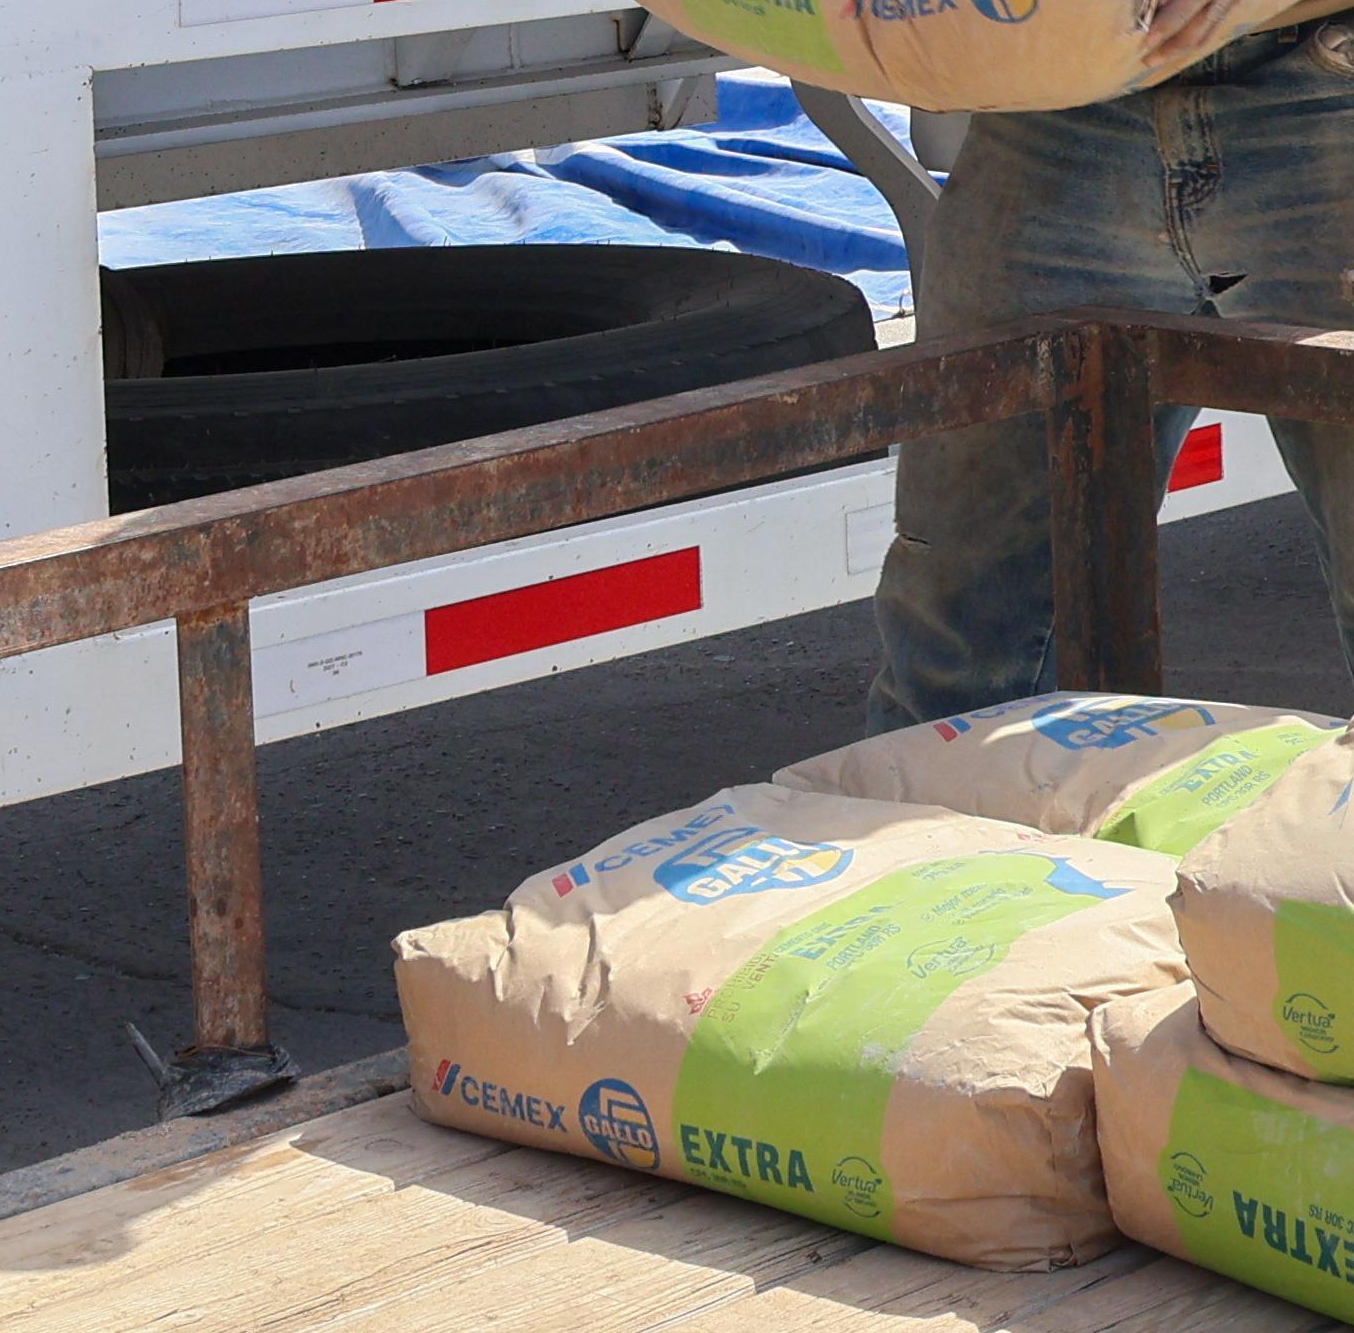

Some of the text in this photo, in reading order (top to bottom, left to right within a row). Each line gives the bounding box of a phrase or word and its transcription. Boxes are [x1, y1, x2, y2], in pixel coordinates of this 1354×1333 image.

[1201, 764, 1253, 808] PORTLAND
[685, 835, 819, 901] GALL
[1281, 1002, 1337, 1030] Vertua
[459, 1074, 884, 1195] CEMEX GALLO EXTRA Vertua
[1166, 1177, 1216, 1213] Vertua
[1308, 1203, 1323, 1219] RS
[1323, 1210, 1347, 1231] 30R
